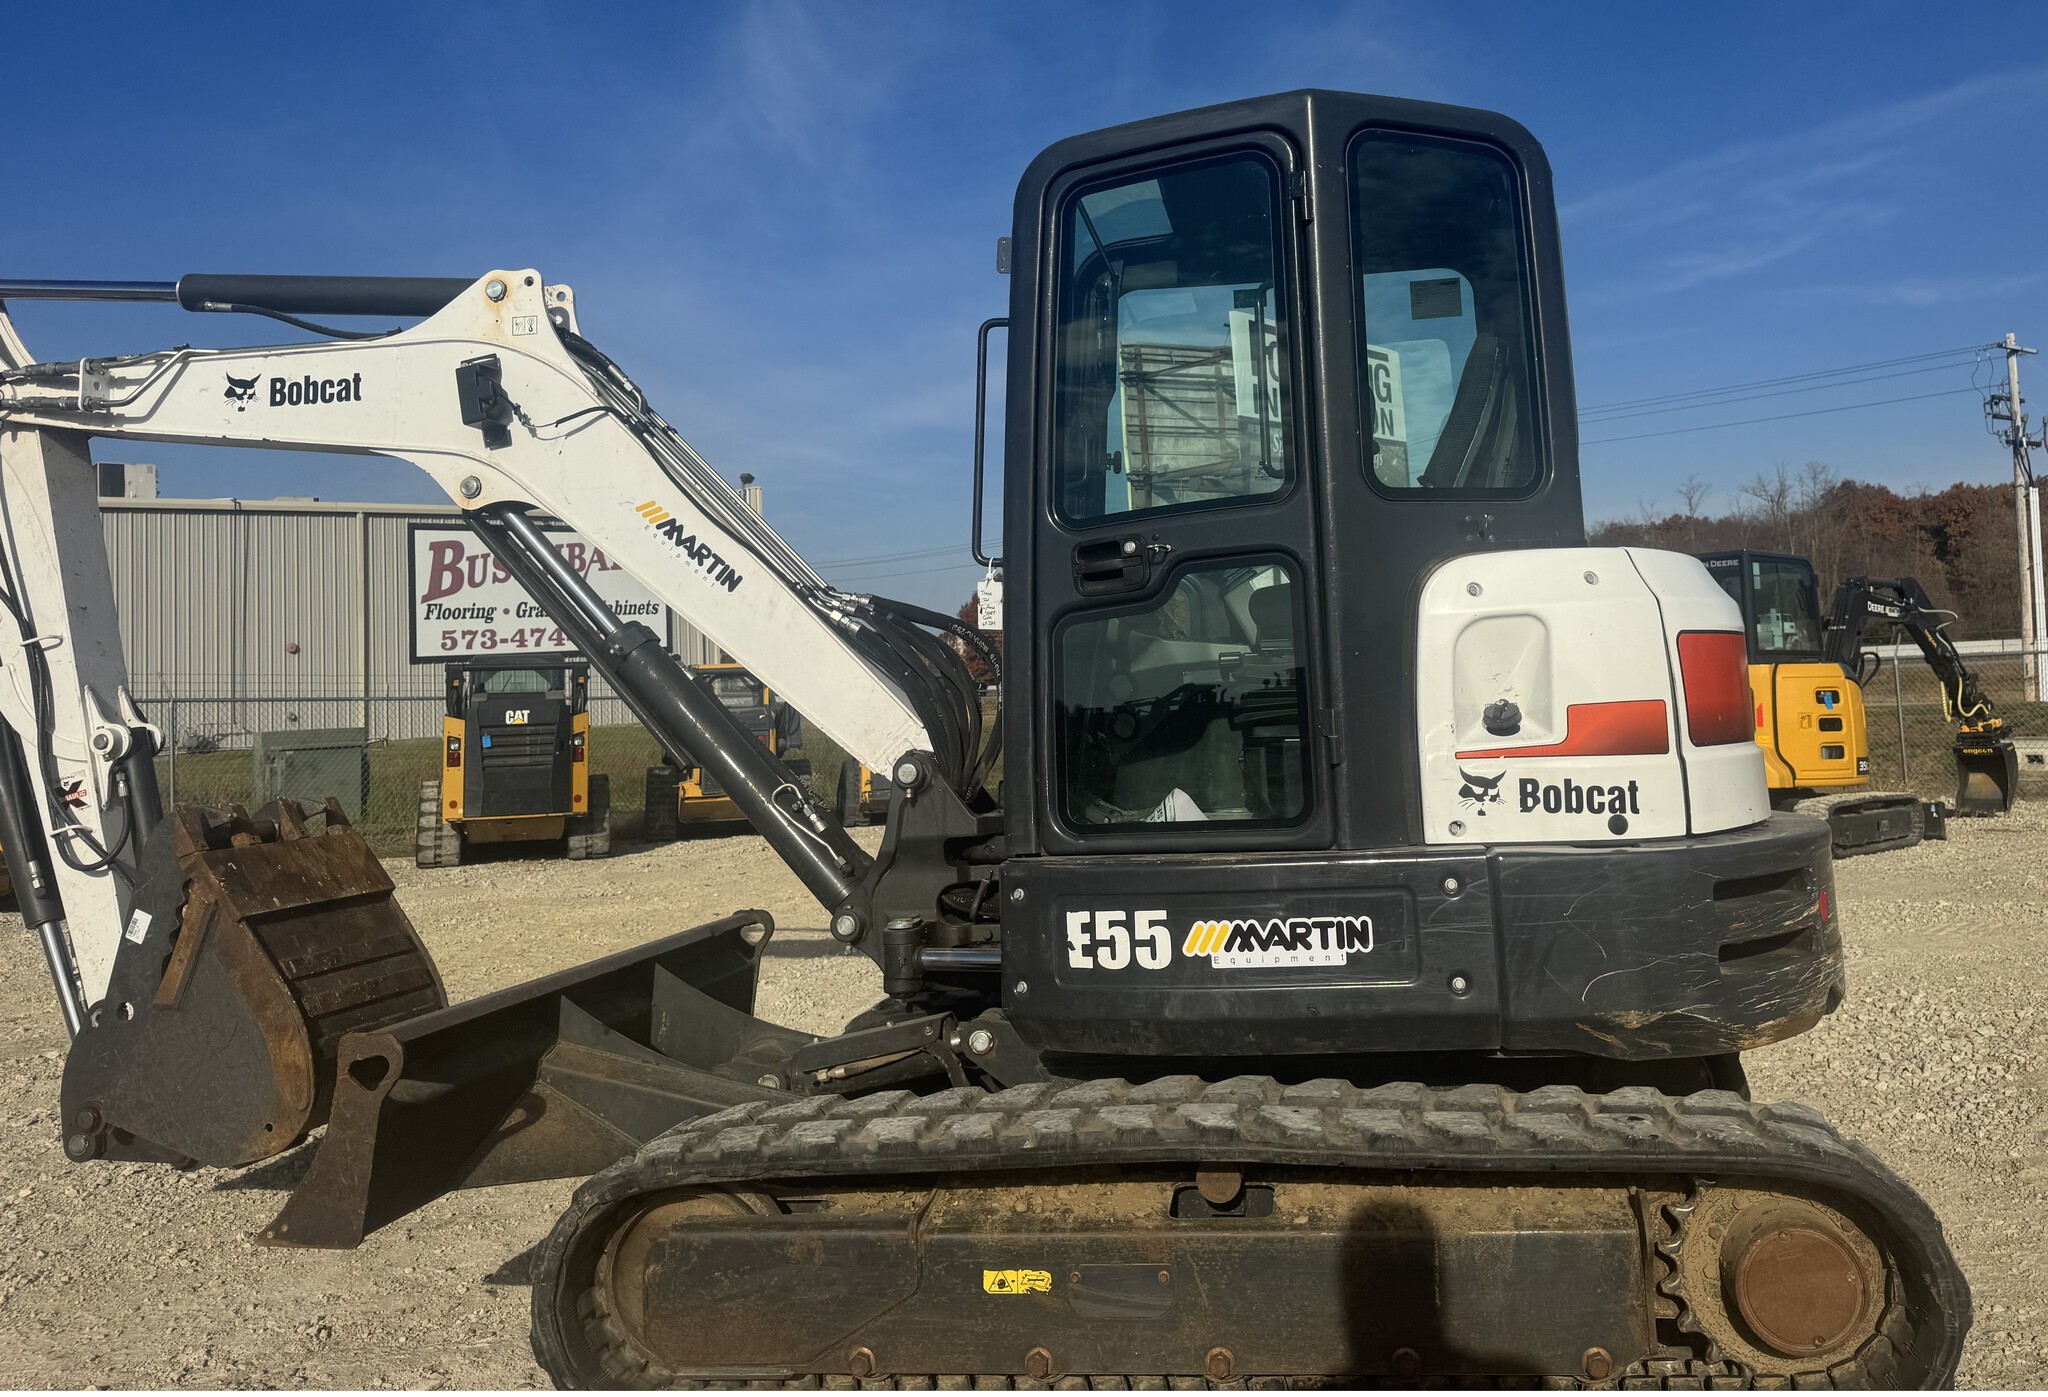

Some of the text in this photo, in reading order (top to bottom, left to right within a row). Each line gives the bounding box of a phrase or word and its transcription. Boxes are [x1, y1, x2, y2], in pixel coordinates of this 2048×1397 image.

[270, 373, 361, 407] Bobcat
[644, 524, 716, 588] Equipment
[655, 517, 744, 593] MARTIN
[1710, 559, 1739, 567] DEERE
[424, 602, 498, 623] Flooring
[1867, 600, 1885, 614] DEERE
[505, 709, 530, 725] CAT
[1519, 778, 1640, 814] Bobcat
[1066, 909, 1172, 970] E55
[1223, 917, 1370, 951] MARTIN
[1213, 953, 1347, 966] Equipment
